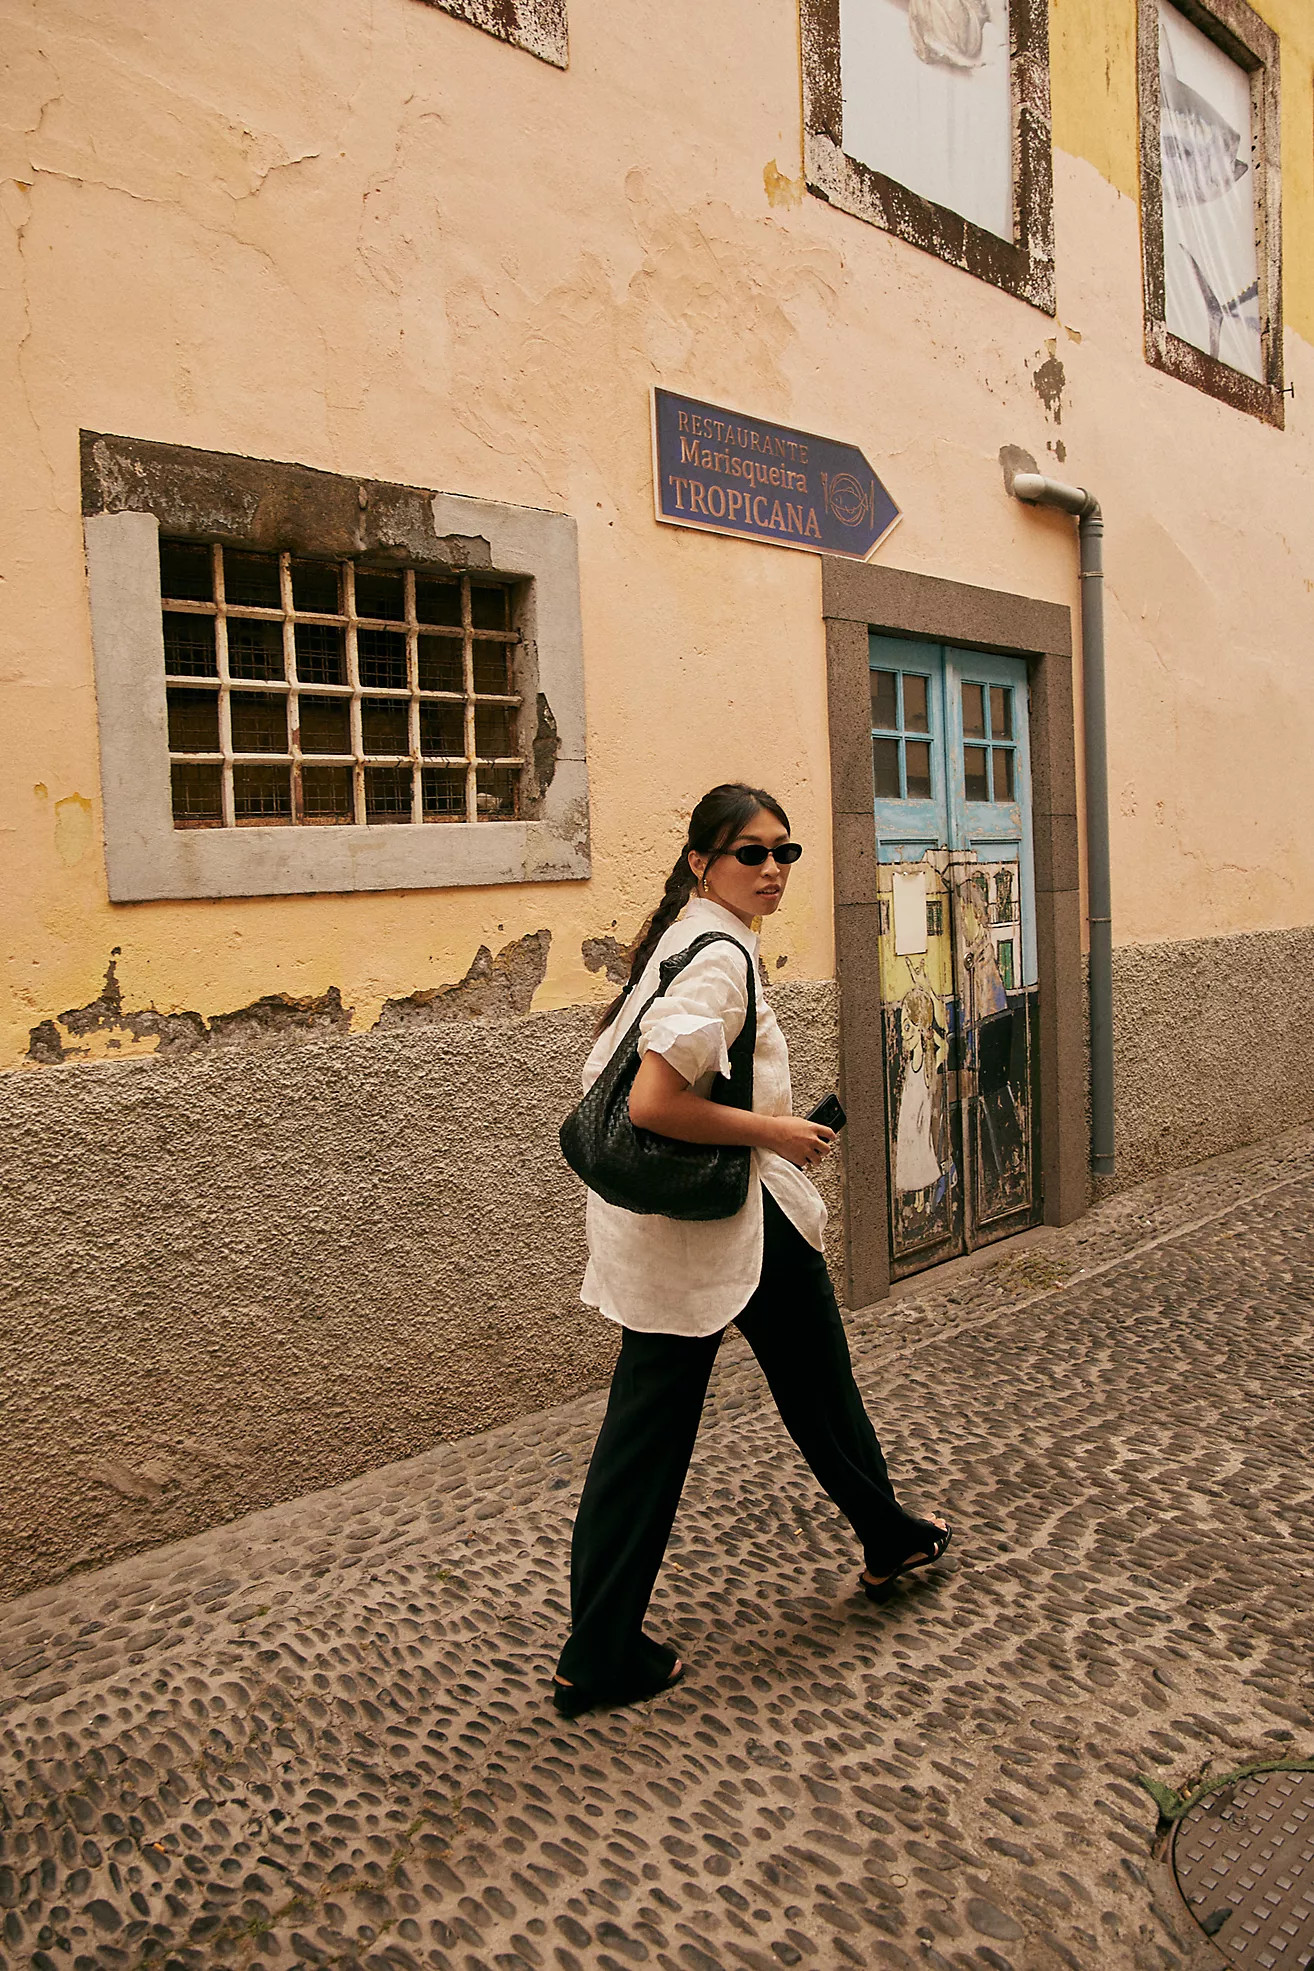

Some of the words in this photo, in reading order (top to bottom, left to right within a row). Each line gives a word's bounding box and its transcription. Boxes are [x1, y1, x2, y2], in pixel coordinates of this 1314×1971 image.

[678, 410, 809, 464] RESTAURANTE
[680, 436, 808, 494] Marisqueira
[669, 475, 822, 539] TROPICANA
